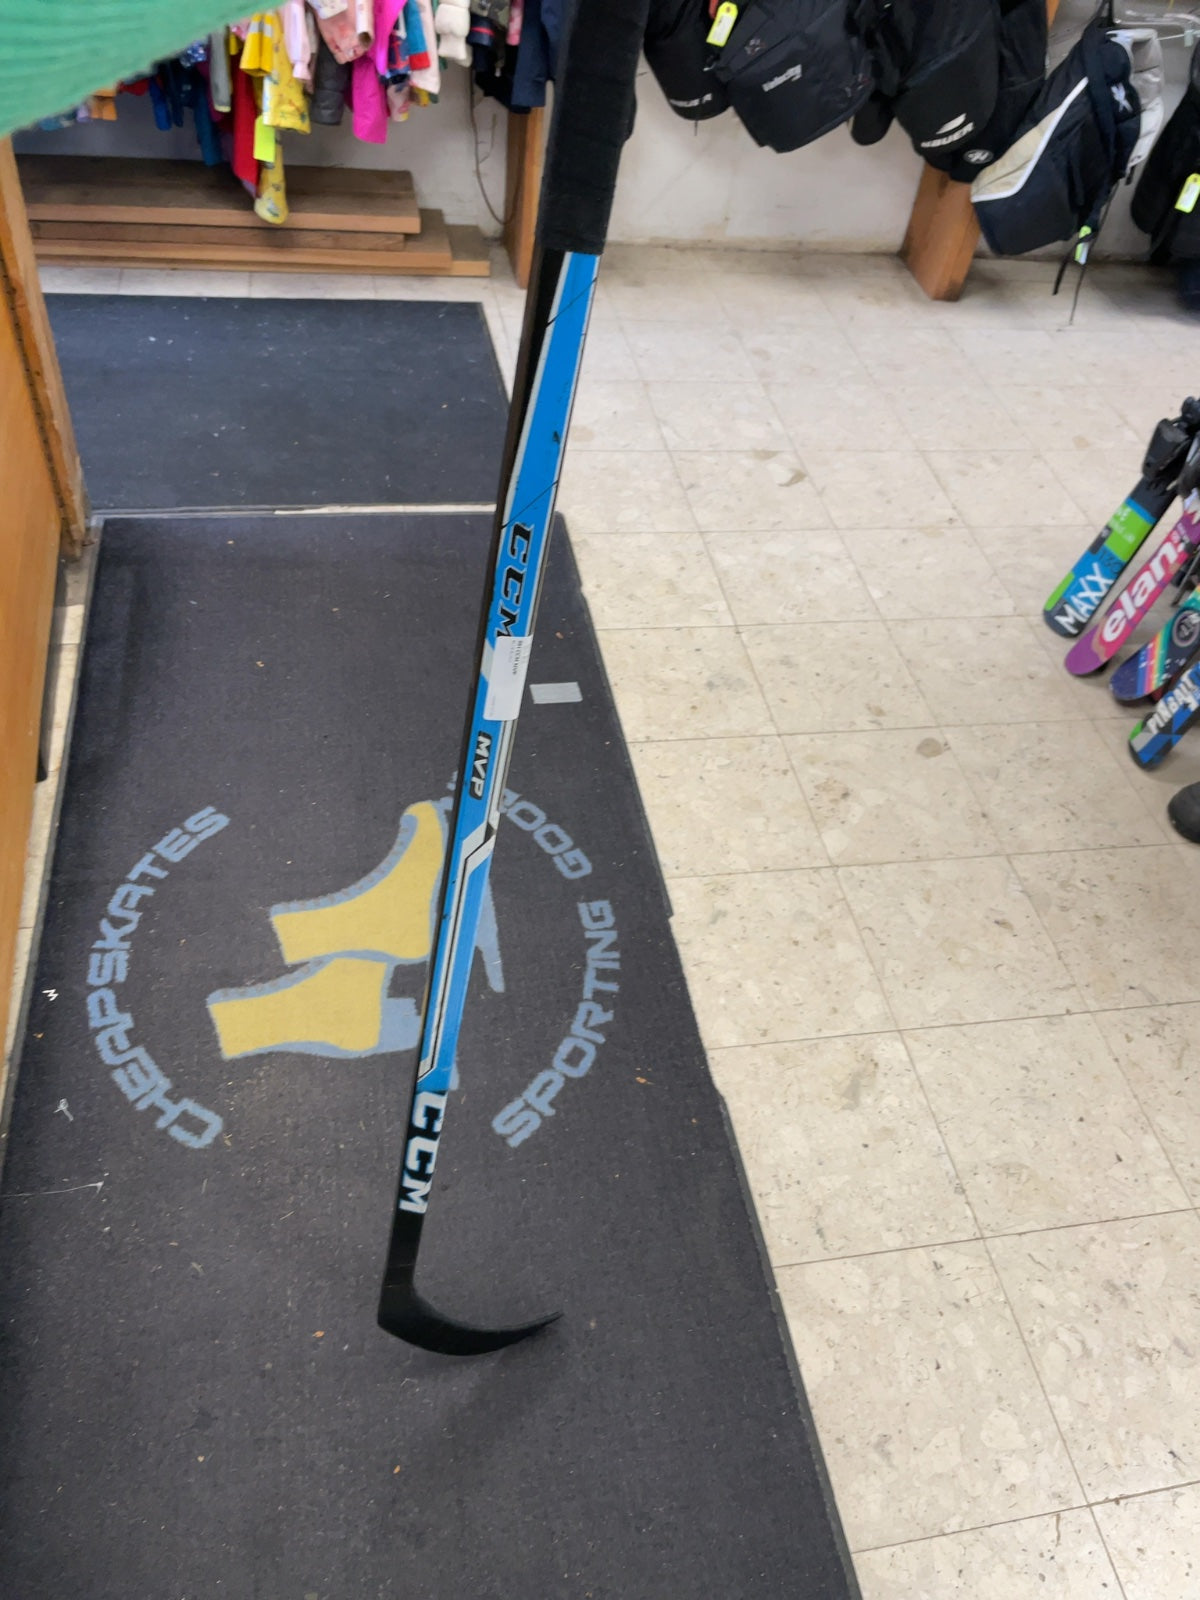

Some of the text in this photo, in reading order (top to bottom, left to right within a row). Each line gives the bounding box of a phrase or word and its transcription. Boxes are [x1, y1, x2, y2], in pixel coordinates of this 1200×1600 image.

[496, 522, 534, 637] CCM
[1054, 562, 1114, 634] MAXX
[471, 735, 491, 797] MVP
[87, 806, 230, 1149] CHEAPSKATES
[492, 900, 621, 1148] SPORTING
[399, 1091, 448, 1214] CCM
